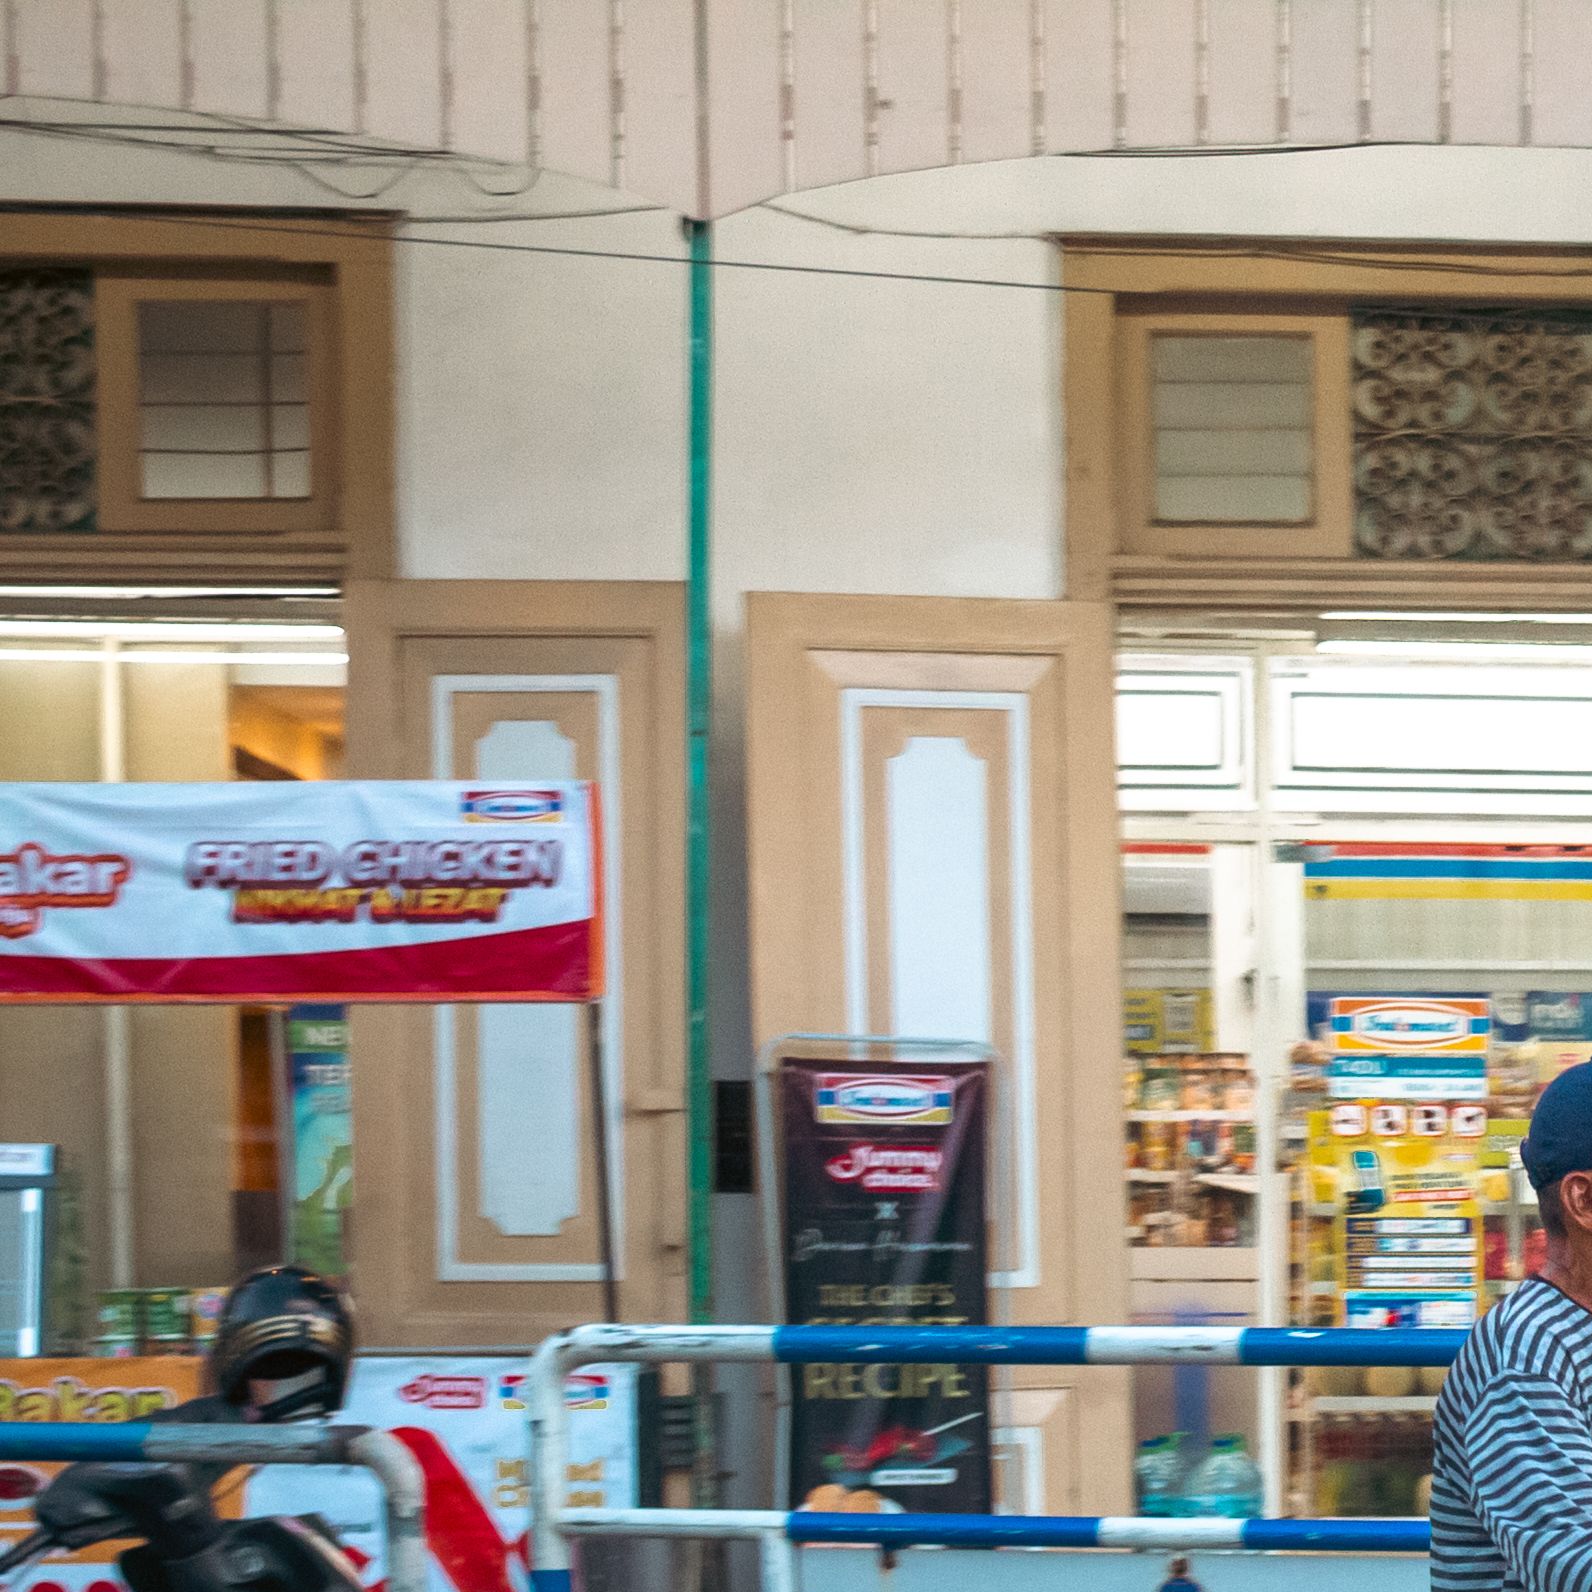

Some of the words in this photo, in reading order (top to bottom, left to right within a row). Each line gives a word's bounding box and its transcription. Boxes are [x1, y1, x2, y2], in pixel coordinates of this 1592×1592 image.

[190, 841, 334, 886] FRIED
[343, 841, 560, 886] CHICKEN
[804, 1362, 971, 1400] RECIPE
